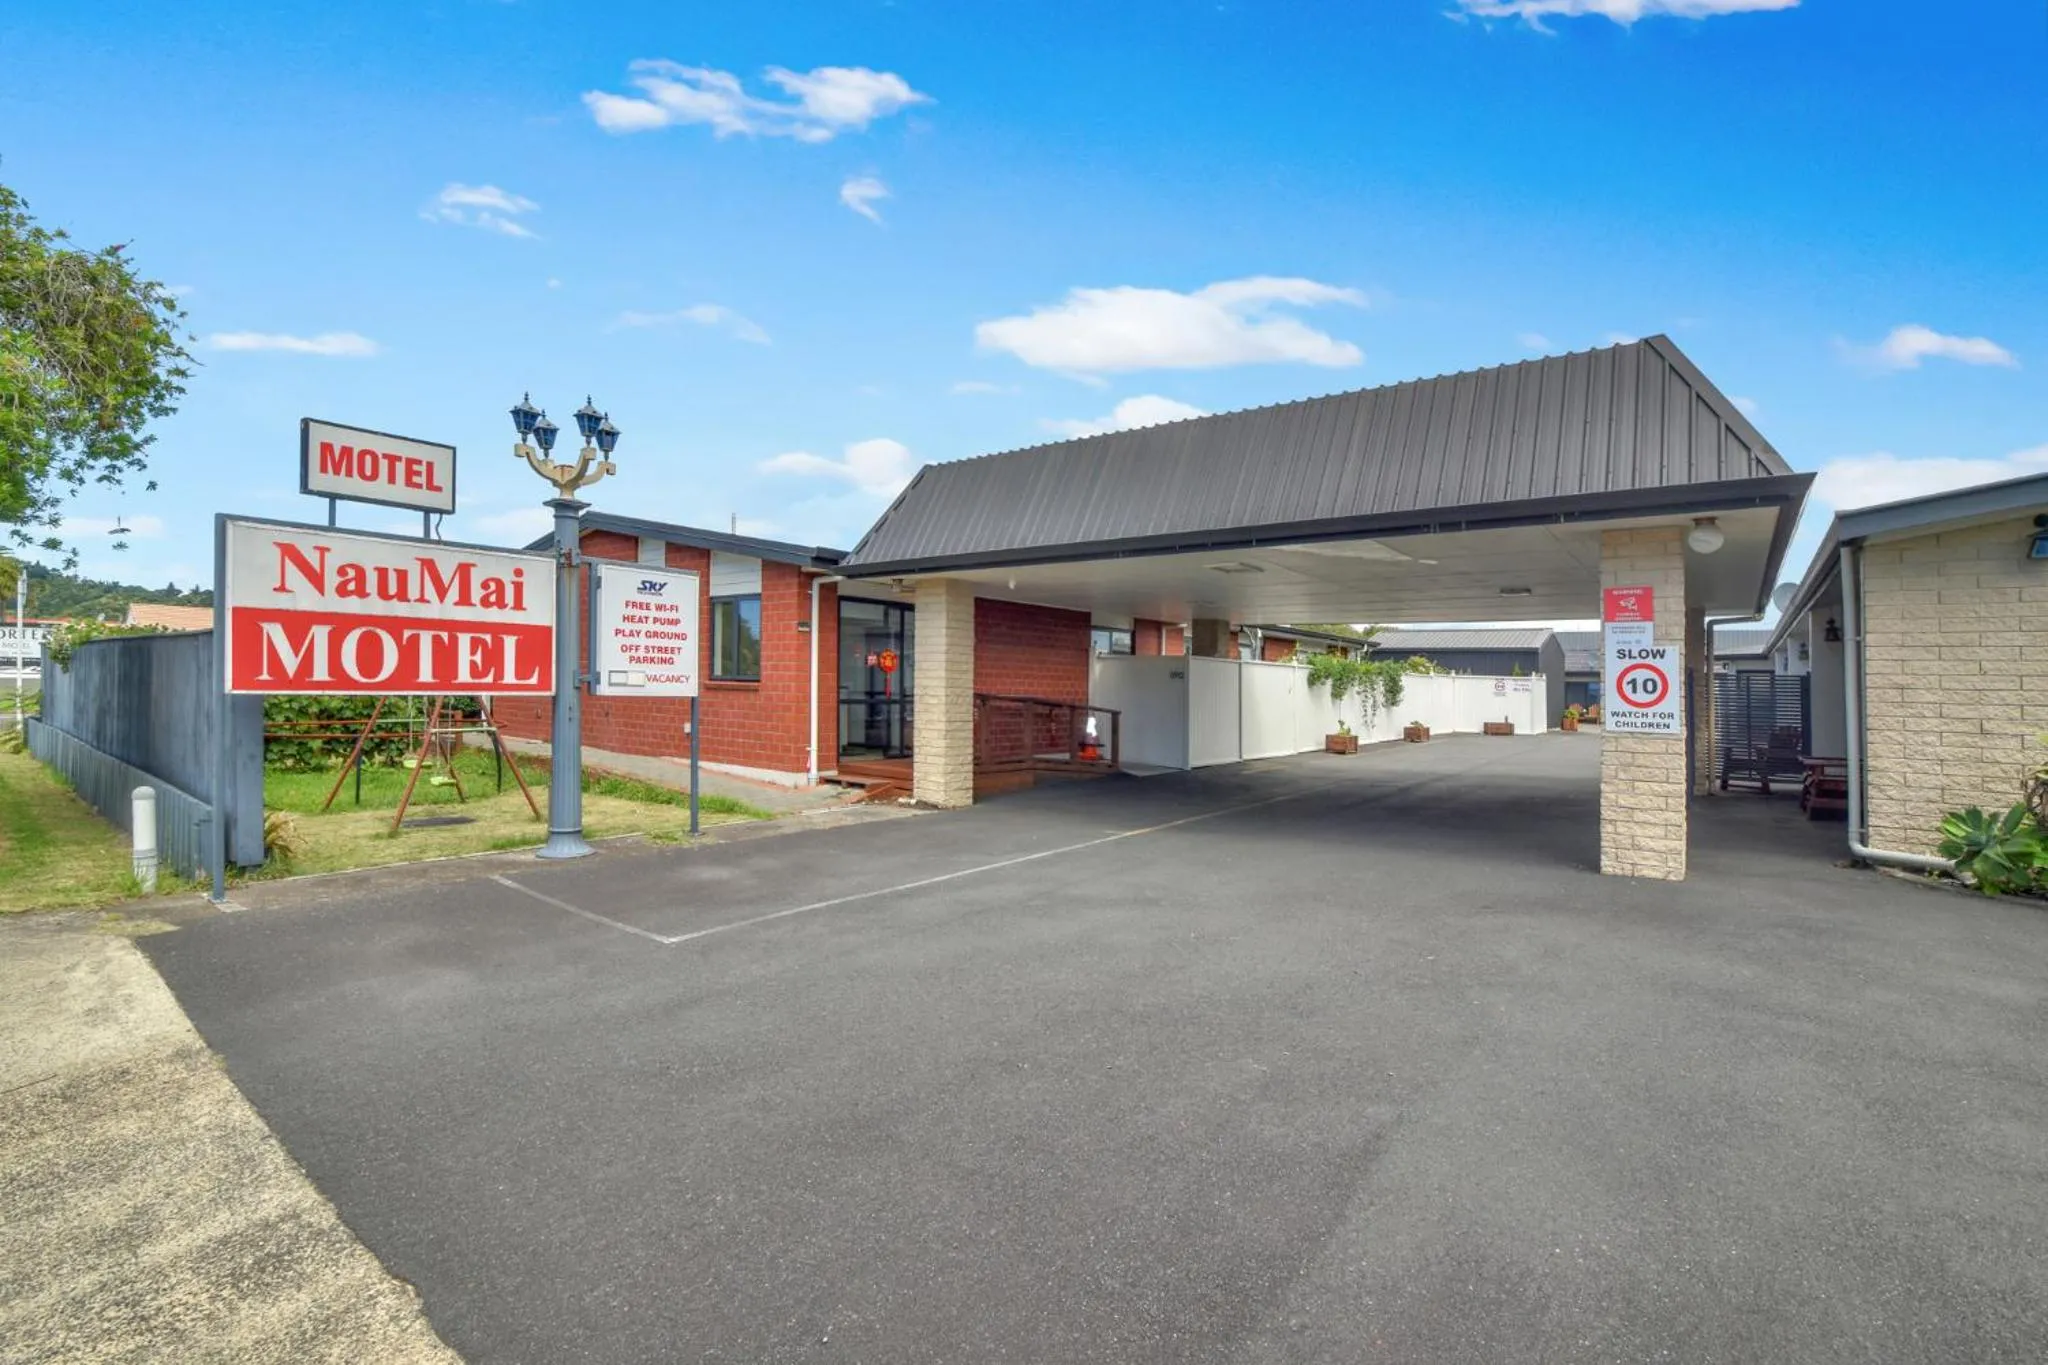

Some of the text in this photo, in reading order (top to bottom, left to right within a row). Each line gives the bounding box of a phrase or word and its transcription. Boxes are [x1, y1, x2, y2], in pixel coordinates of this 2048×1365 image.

[319, 441, 443, 493] MOTEL
[273, 541, 527, 612] NauMai
[637, 580, 667, 591] SKY
[624, 600, 680, 613] FREE WI-FI
[622, 614, 681, 626] HEAT PUMP
[614, 628, 688, 641] PLAY GROUND
[255, 622, 540, 686] MOTEL
[620, 644, 683, 656] OFF STREET
[1616, 648, 1666, 660] SLOW
[628, 655, 675, 665] PARKING
[646, 674, 690, 684] VACANCY
[1626, 678, 1658, 695] 10
[1610, 710, 1675, 720] WATCH FOR
[1614, 720, 1671, 730] CHILDREN
